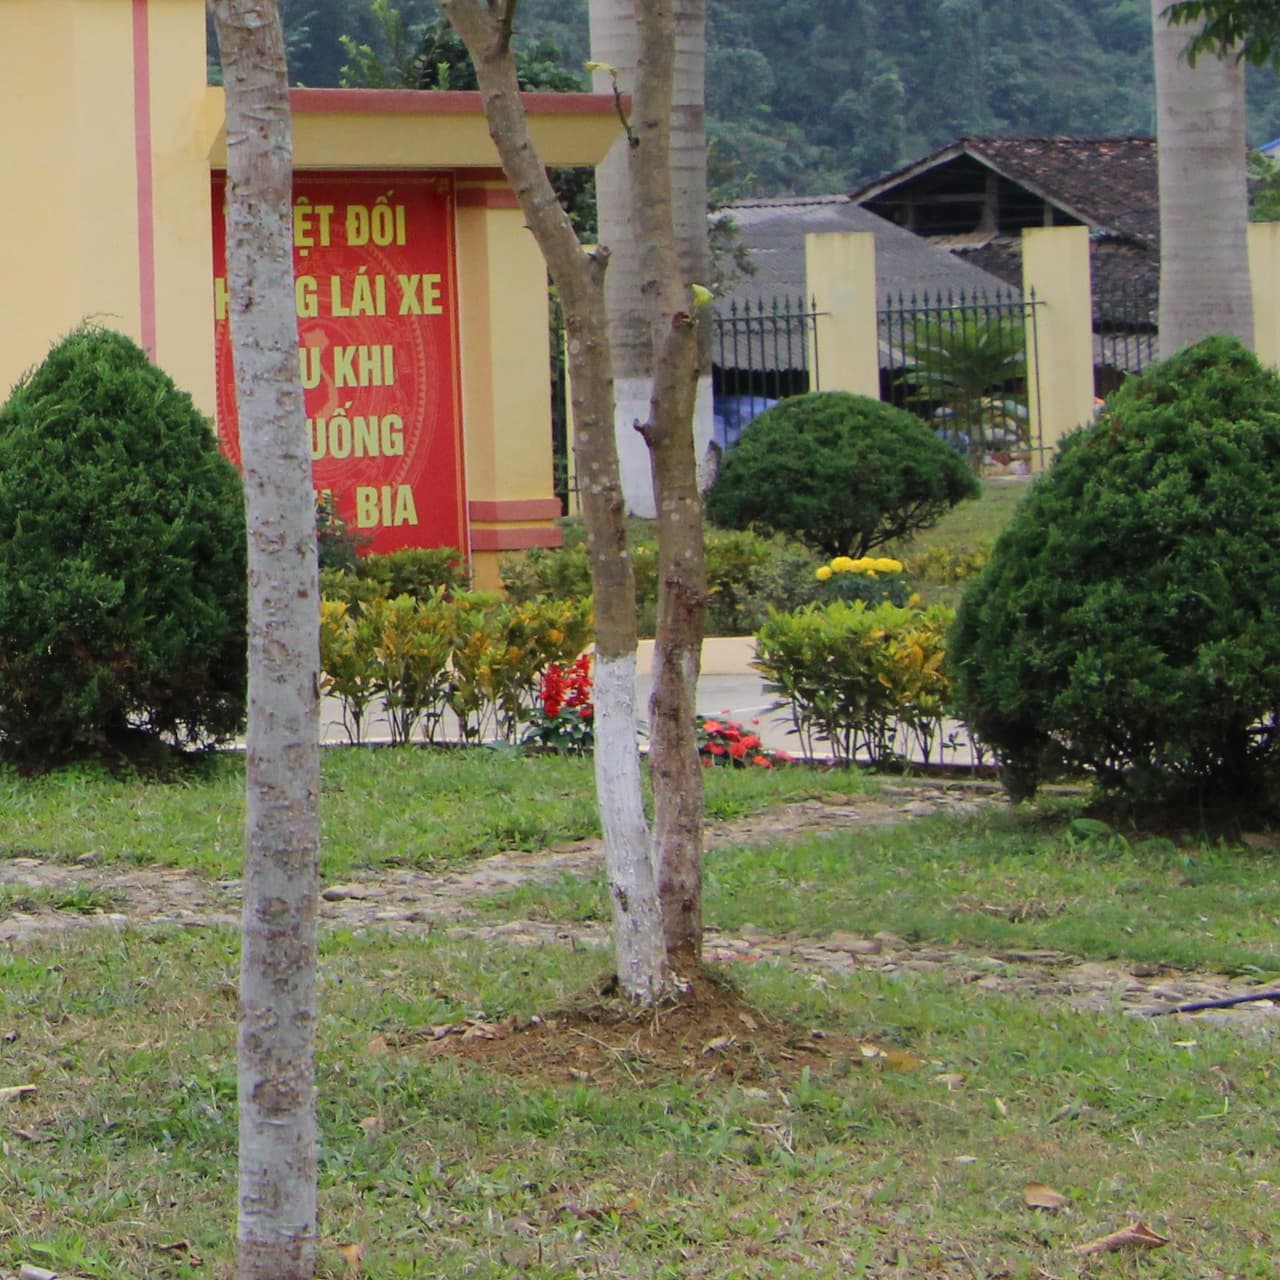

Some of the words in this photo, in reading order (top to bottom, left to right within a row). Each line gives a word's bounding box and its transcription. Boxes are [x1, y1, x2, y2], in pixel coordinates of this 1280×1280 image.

[345, 190, 407, 246] ĐỐI
[331, 266, 386, 317] LÁI
[398, 274, 443, 316] XE
[333, 344, 394, 388] KHI
[306, 401, 404, 460] UỐNG
[356, 484, 418, 528] BIA
